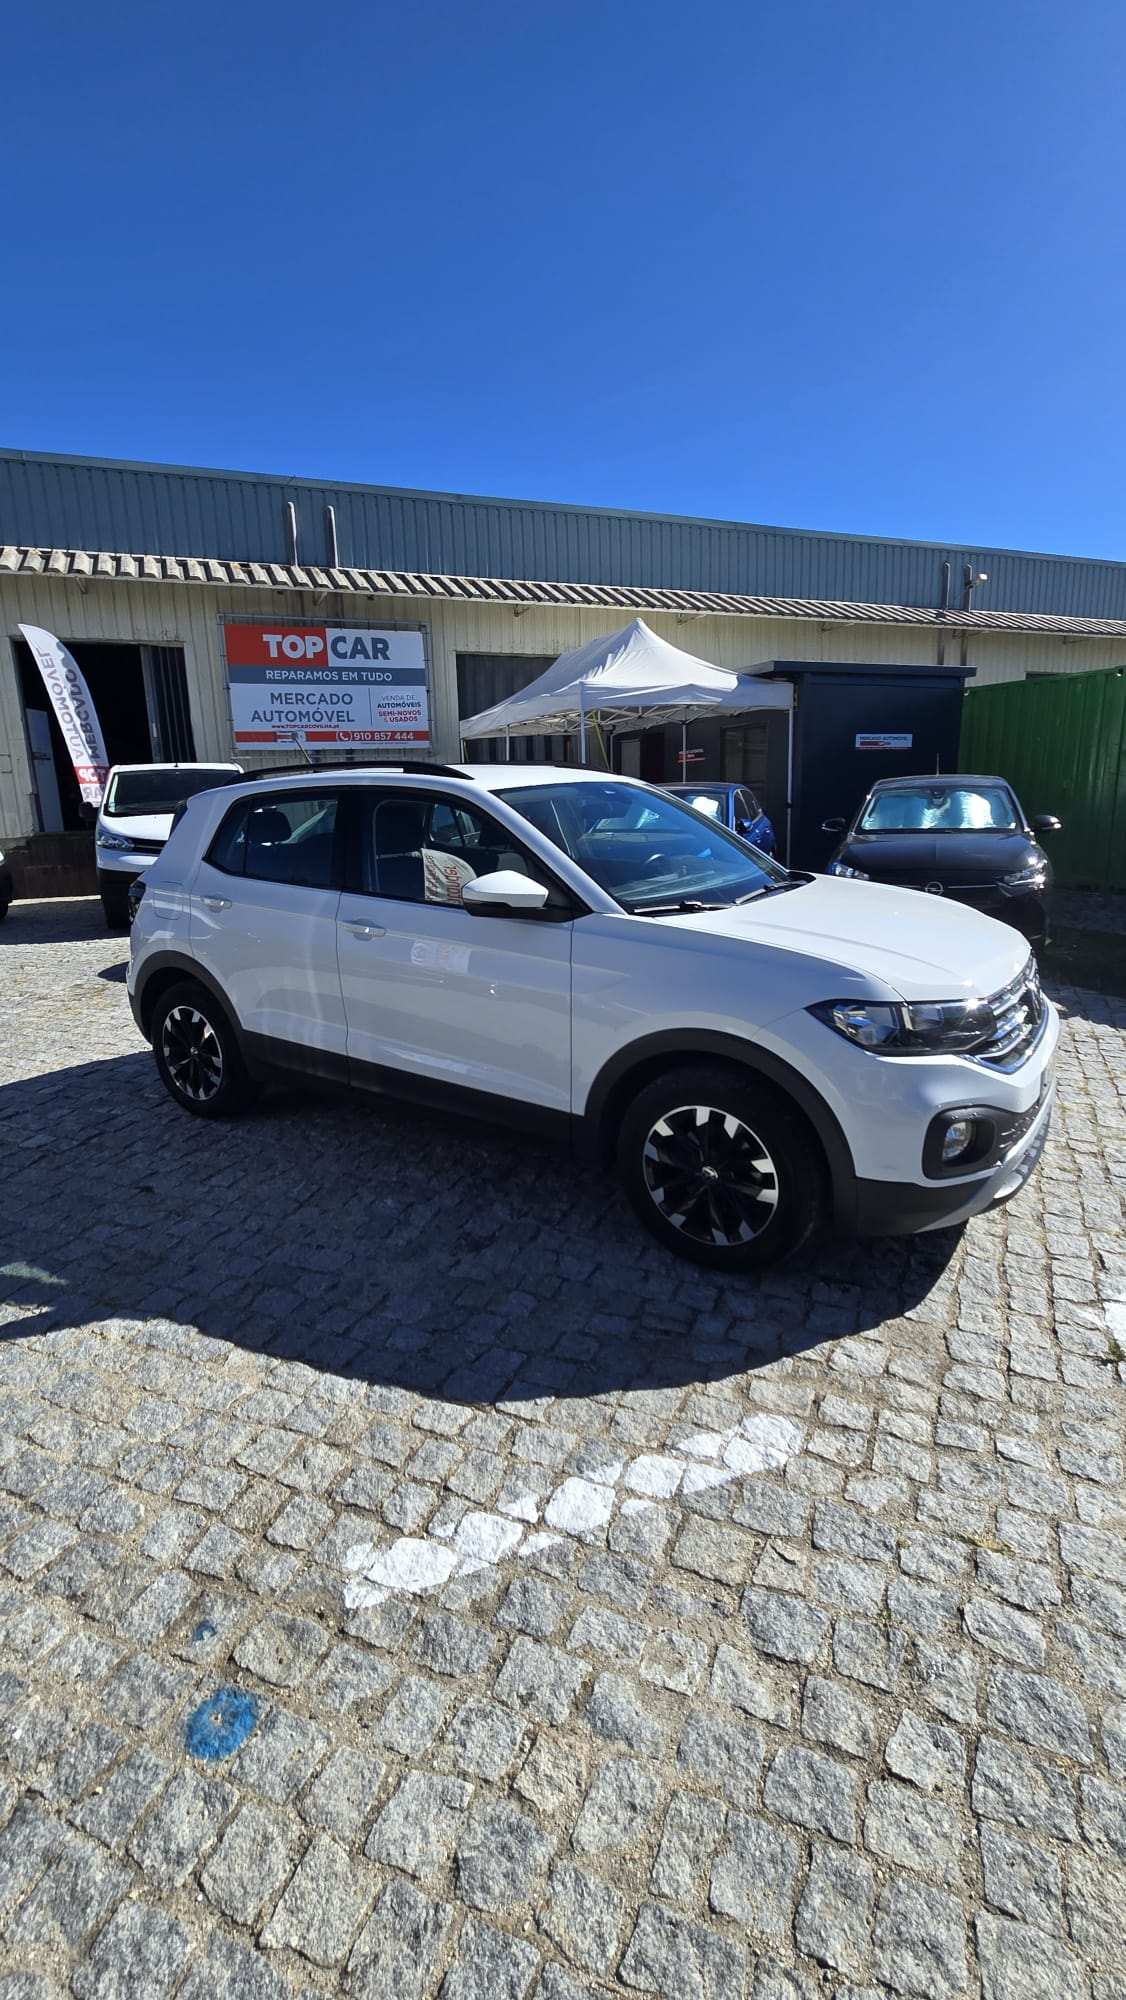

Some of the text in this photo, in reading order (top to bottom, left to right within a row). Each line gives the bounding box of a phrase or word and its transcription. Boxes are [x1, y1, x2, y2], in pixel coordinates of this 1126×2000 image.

[265, 669, 393, 682] REPARAMOS EM TUDO
[270, 692, 353, 705] MERCADO
[251, 707, 356, 722] AUTOMÓVEL
[353, 732, 415, 741] 910 857 444
